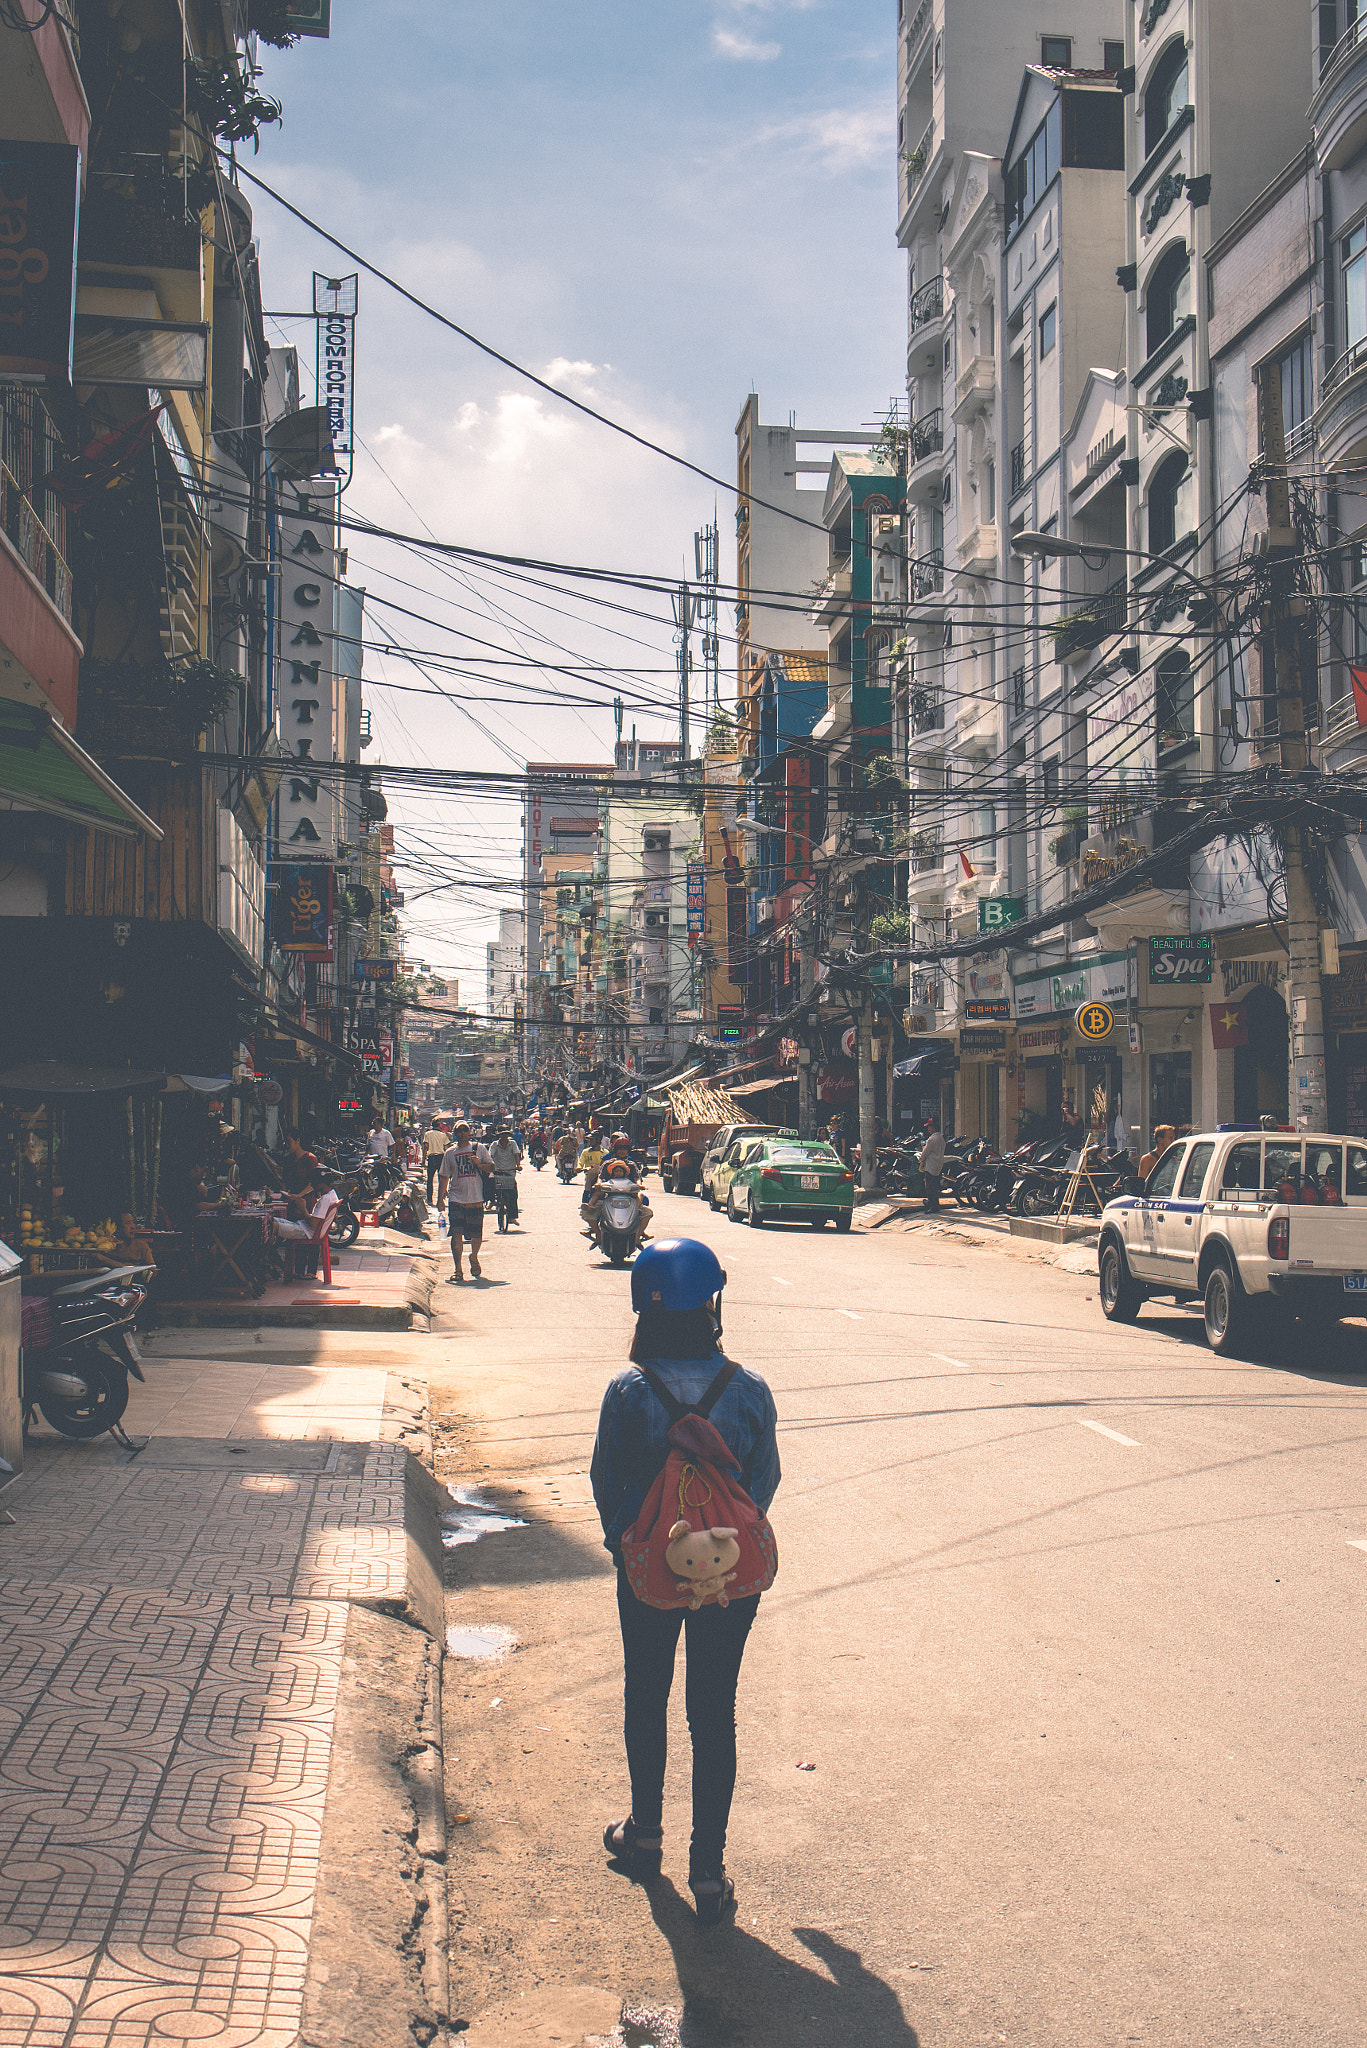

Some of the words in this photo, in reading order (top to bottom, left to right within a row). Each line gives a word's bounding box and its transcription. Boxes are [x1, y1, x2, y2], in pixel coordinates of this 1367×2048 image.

[532, 792, 542, 866] HOTEL
[688, 885, 703, 894] RENT
[290, 875, 322, 935] Tiger
[687, 895, 703, 910] 96
[1153, 940, 1195, 949] BEAUTIFUL
[364, 964, 392, 979] Tiger
[1154, 953, 1207, 979] Spa
[350, 1031, 377, 1050] SPA
